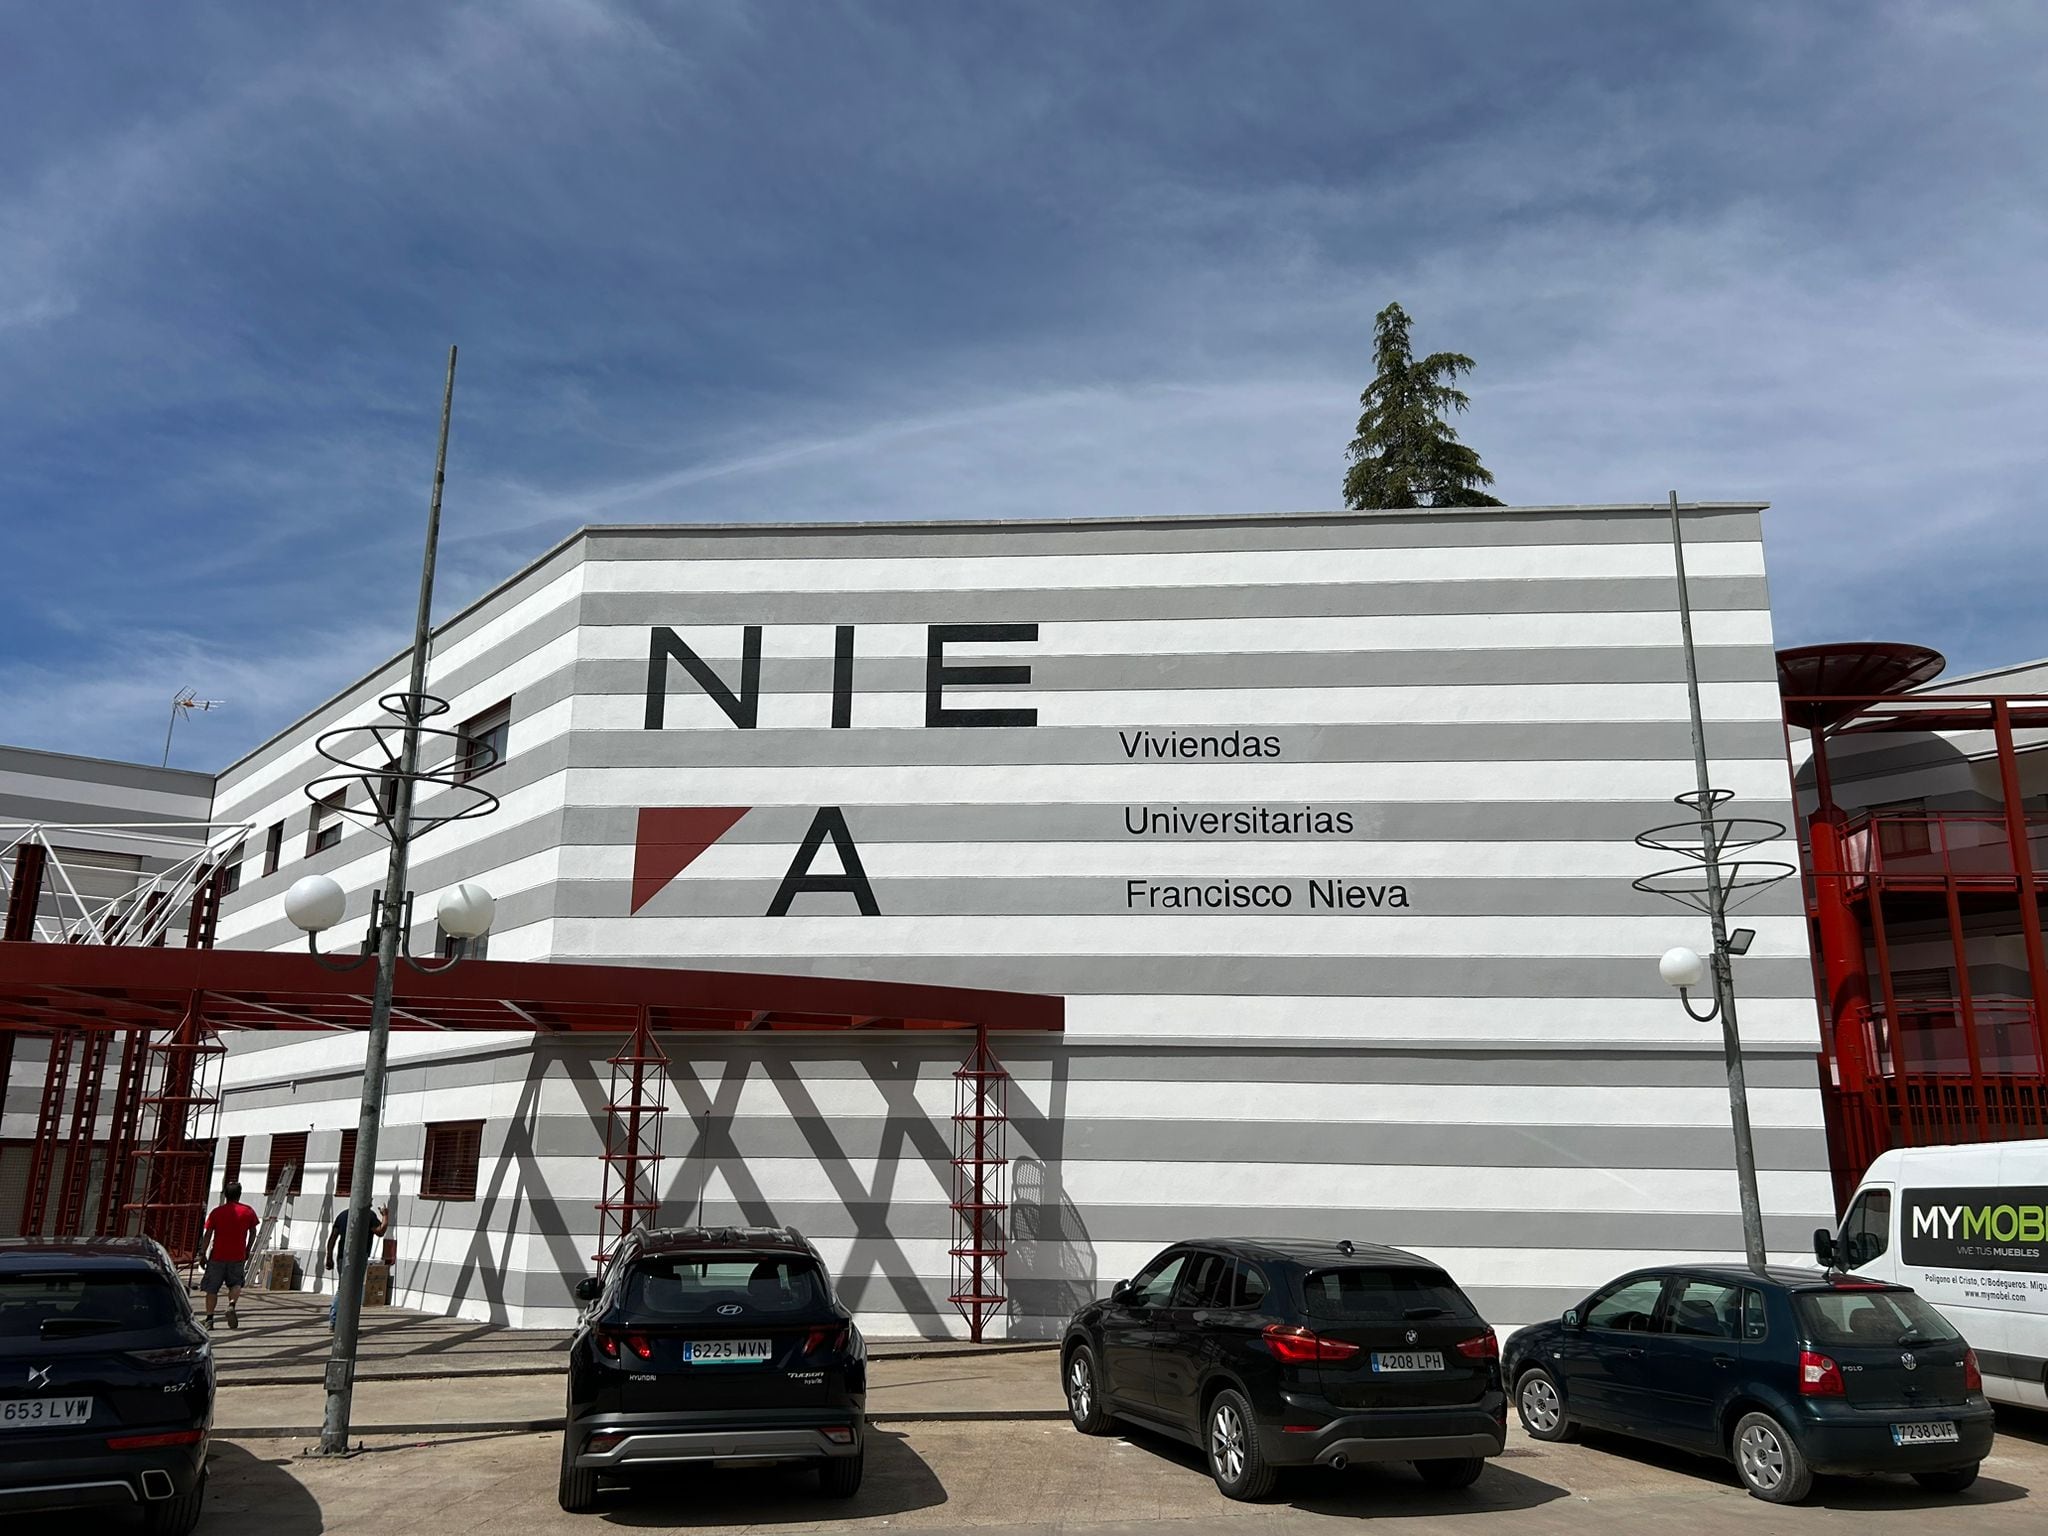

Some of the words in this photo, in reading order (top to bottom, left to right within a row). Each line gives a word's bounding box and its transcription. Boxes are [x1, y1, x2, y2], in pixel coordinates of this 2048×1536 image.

[644, 623, 1039, 730] NIE
[1119, 730, 1281, 758] Viviendas
[1125, 805, 1354, 837] Universitarias
[764, 806, 882, 918] A
[1127, 878, 1293, 910] Francisco
[1308, 879, 1410, 910] Nieva
[1912, 1204, 2048, 1242] MYMOB
[1956, 1246, 1974, 1255] VIVE
[1976, 1246, 1992, 1256] TUS
[1993, 1247, 2040, 1258] MUEBLES
[1952, 1275, 1958, 1284] el
[693, 1343, 732, 1358] 6225
[737, 1342, 768, 1357] MVN
[1382, 1354, 1413, 1369] 4208
[1416, 1354, 1441, 1369] LPH
[0, 1402, 43, 1420] 653
[49, 1400, 88, 1418] LVW
[1899, 1424, 1931, 1440] 7238
[1932, 1423, 1953, 1438] CVF
